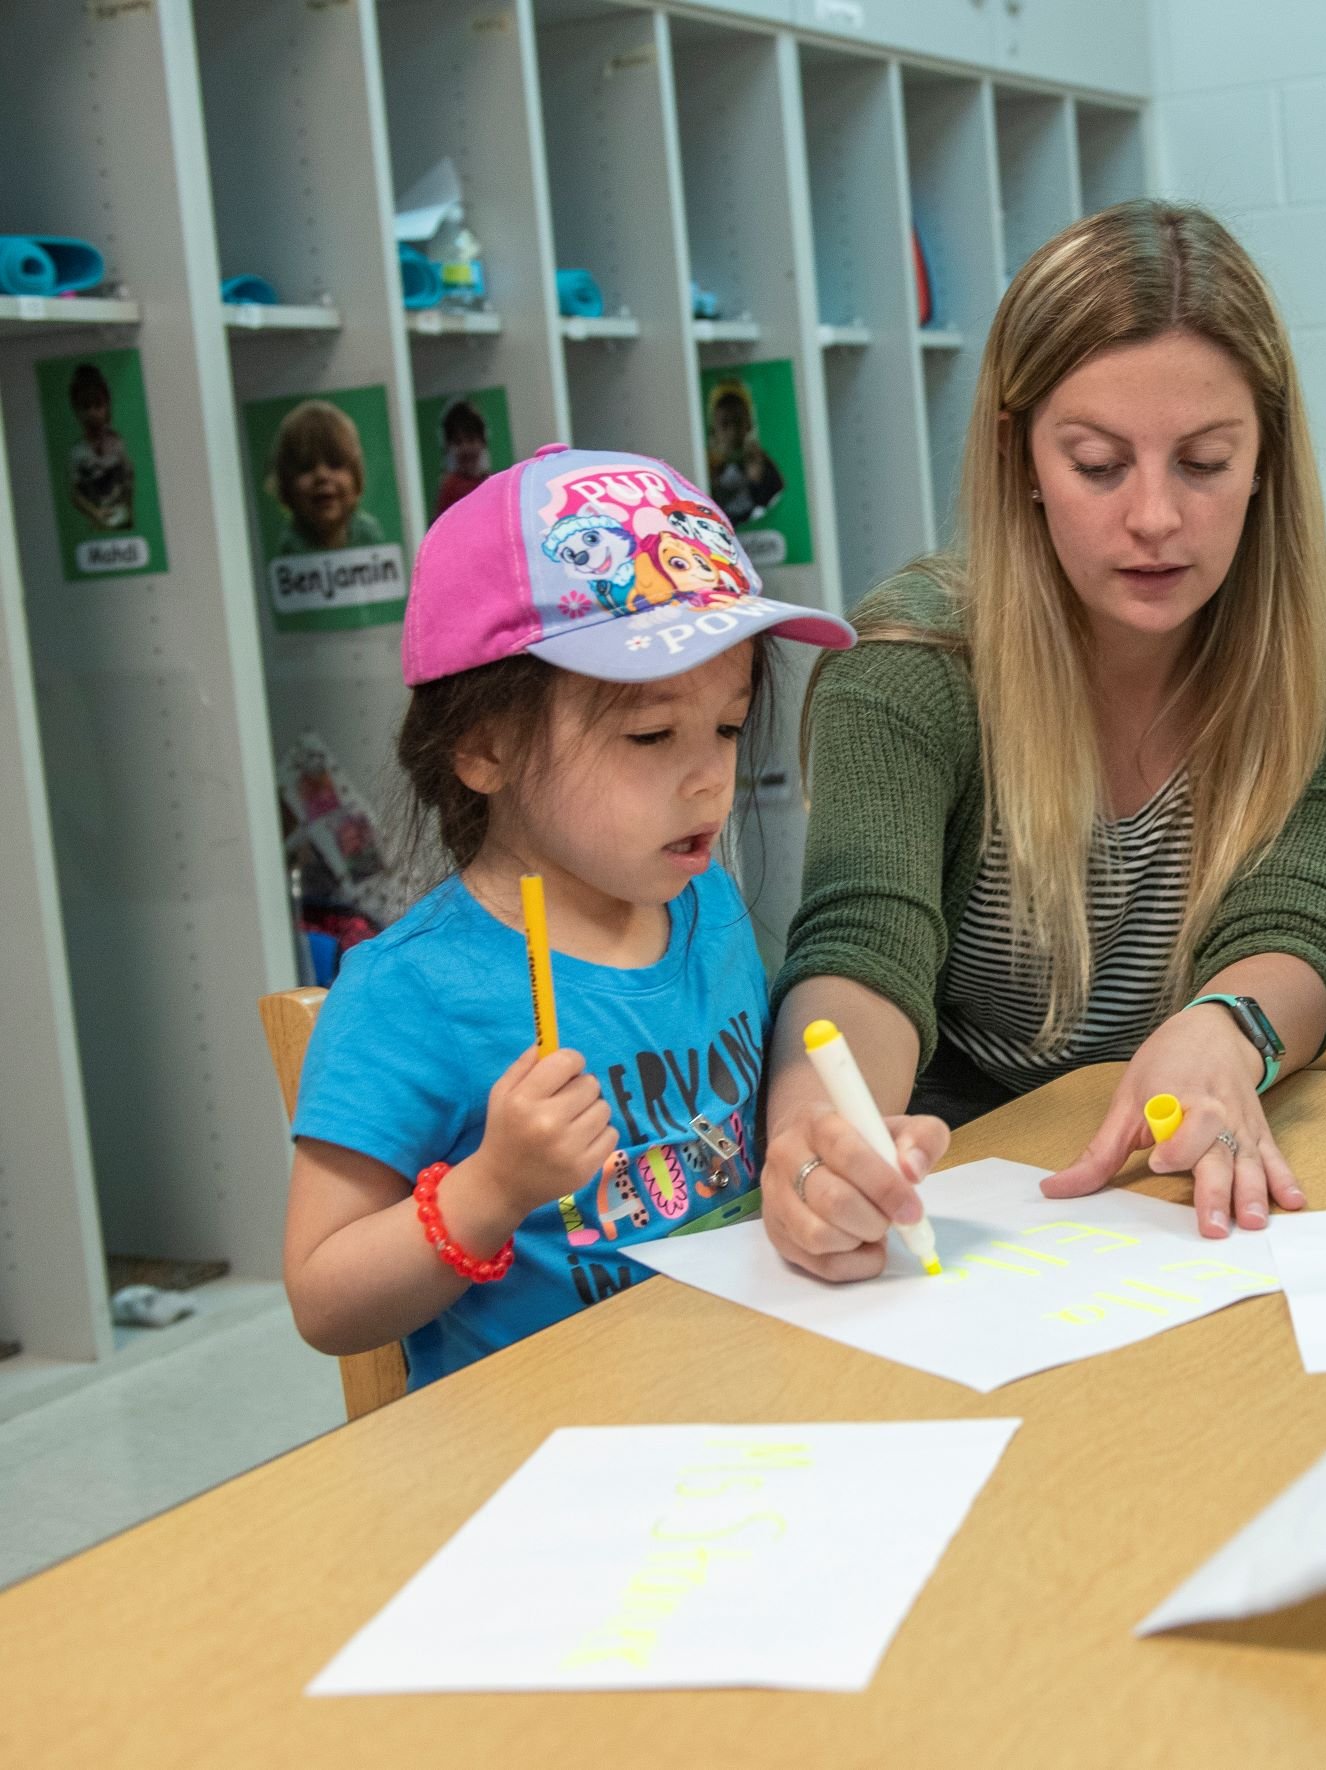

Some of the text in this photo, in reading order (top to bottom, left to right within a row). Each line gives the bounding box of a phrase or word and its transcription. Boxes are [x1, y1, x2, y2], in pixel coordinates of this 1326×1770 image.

[570, 473, 666, 509] PUP
[275, 553, 398, 599] Benjamin
[1042, 1258, 1279, 1325] Ella
